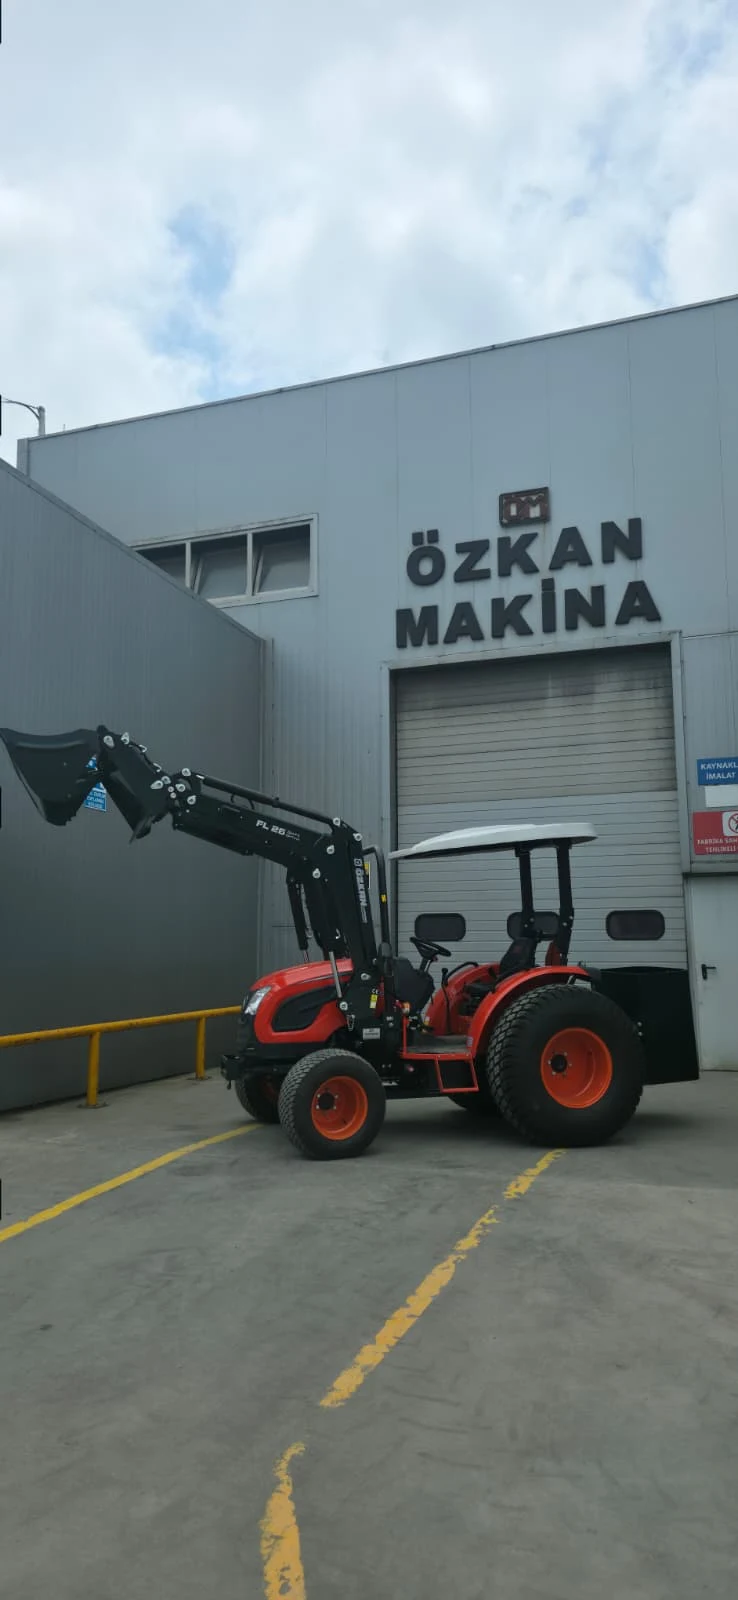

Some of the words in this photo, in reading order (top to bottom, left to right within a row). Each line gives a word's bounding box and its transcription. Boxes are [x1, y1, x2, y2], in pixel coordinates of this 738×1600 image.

[406, 518, 643, 585] ÖZKAN
[397, 577, 661, 649] MAKİNA
[256, 819, 269, 830] FL
